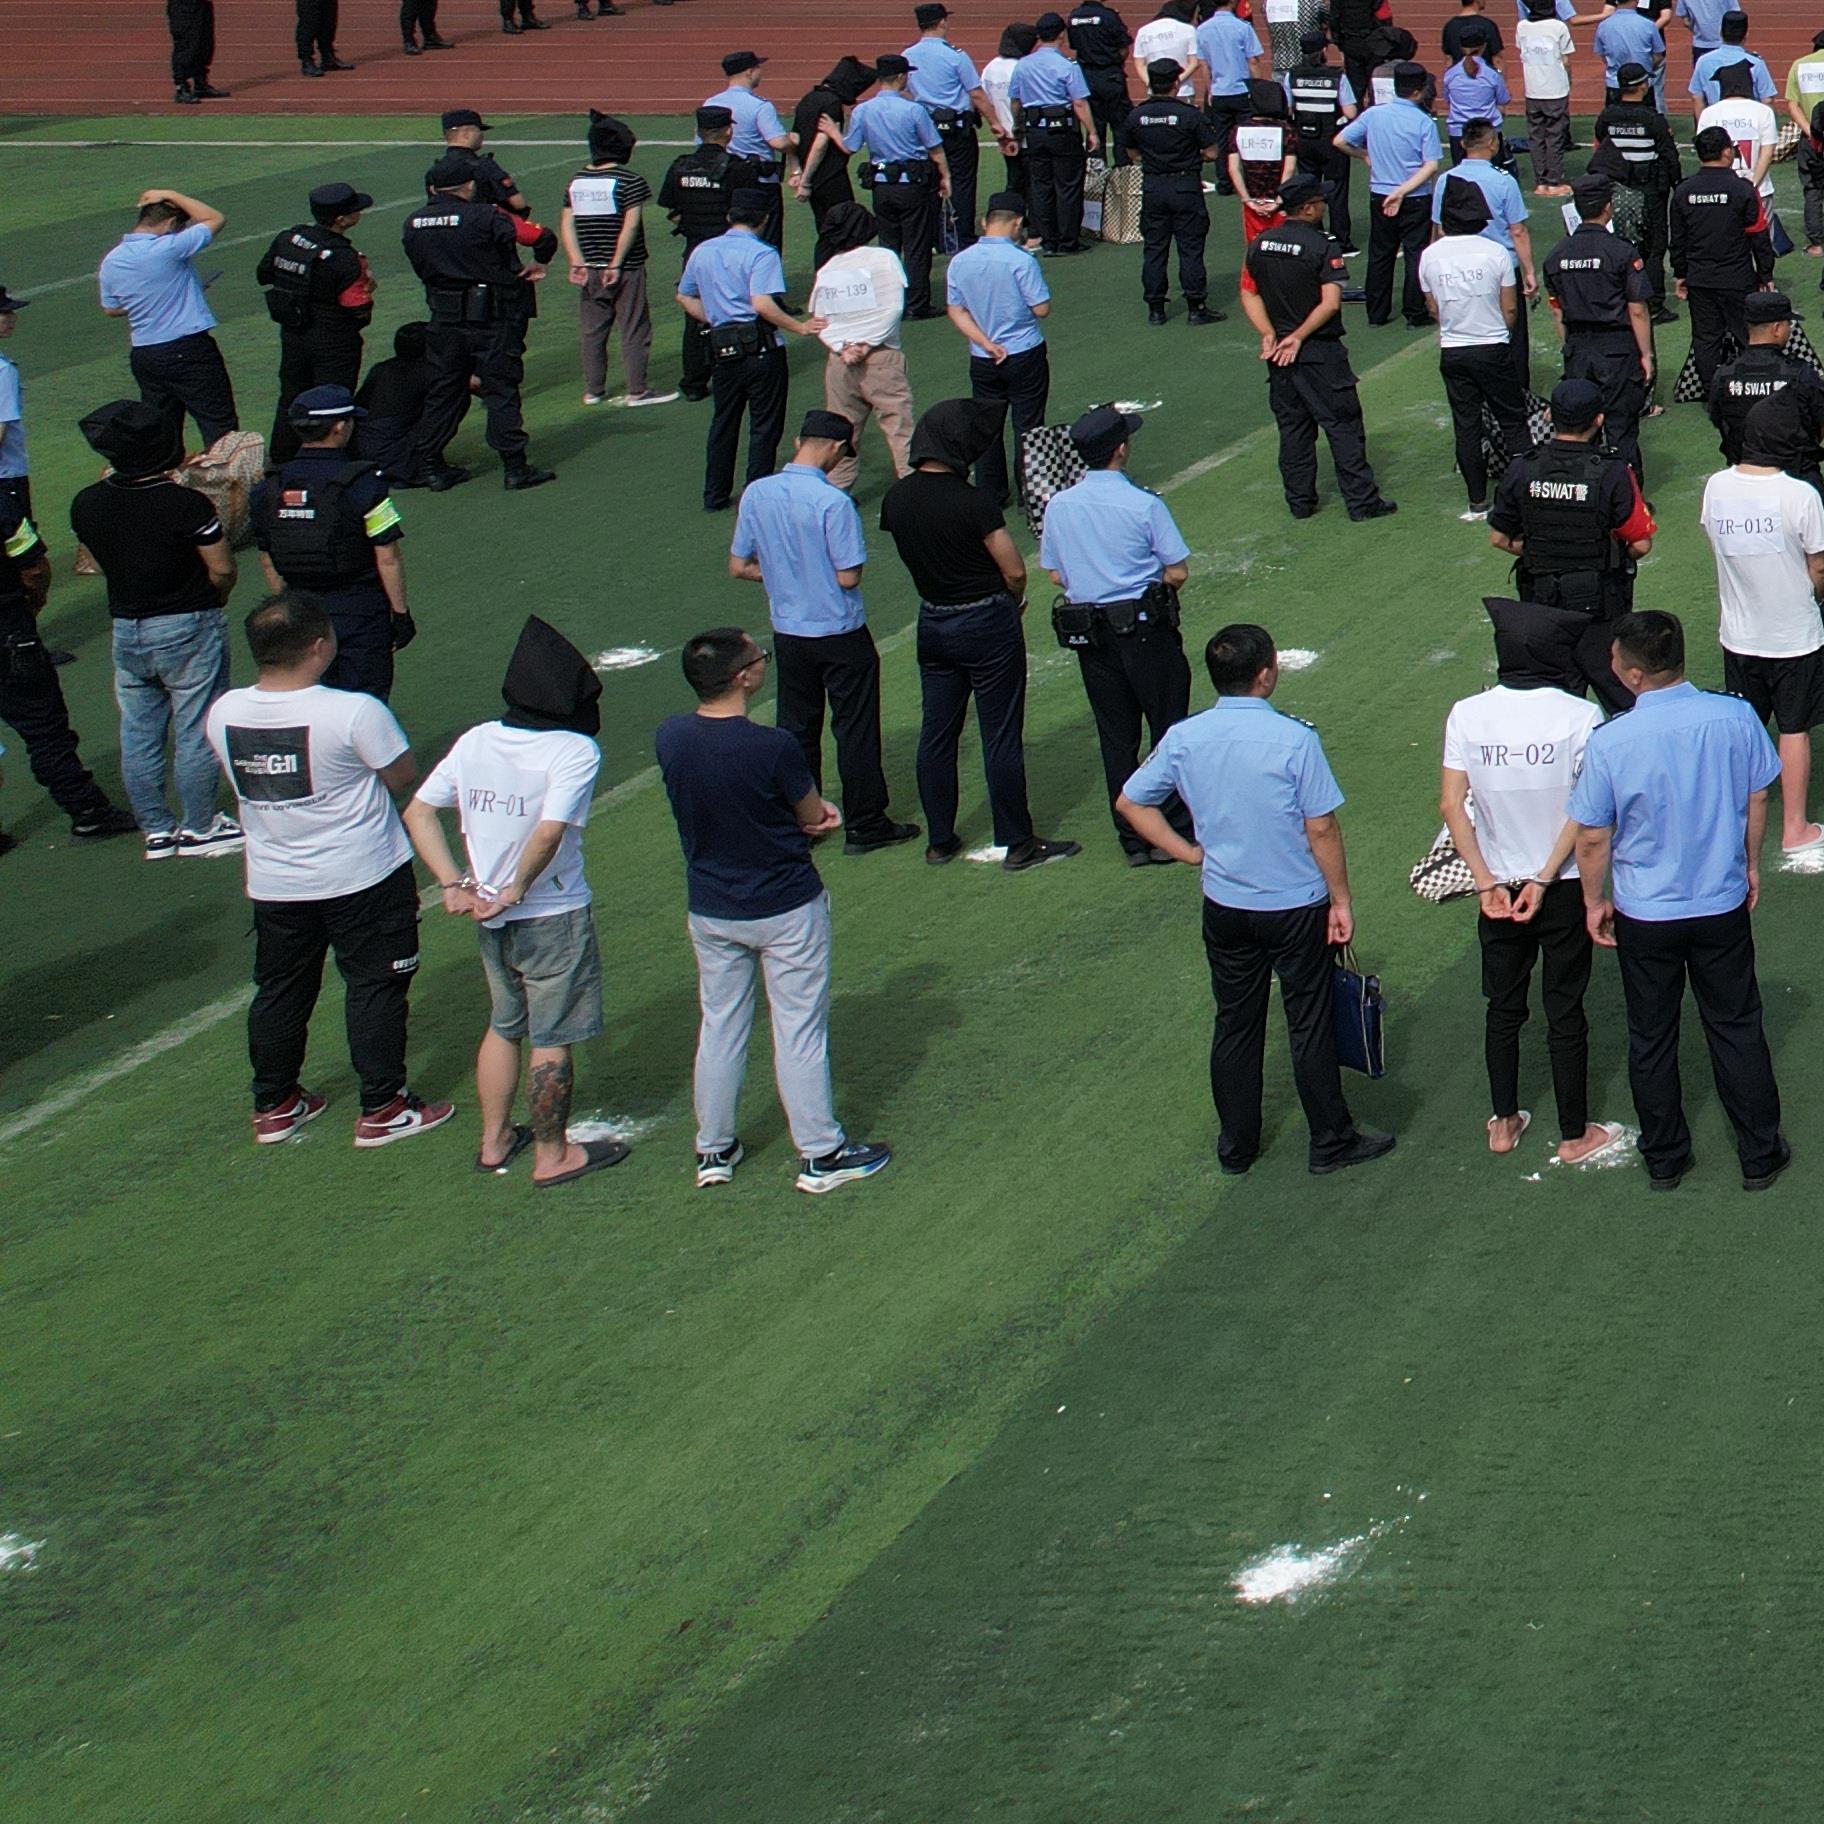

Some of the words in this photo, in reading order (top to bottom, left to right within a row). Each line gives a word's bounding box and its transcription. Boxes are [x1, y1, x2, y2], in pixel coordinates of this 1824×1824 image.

[1438, 268, 1484, 287] FR-138
[826, 283, 868, 299] FR-139
[1717, 518, 1774, 535] ZR-013
[1480, 744, 1555, 767] WR-02
[469, 788, 528, 817] WR-01
